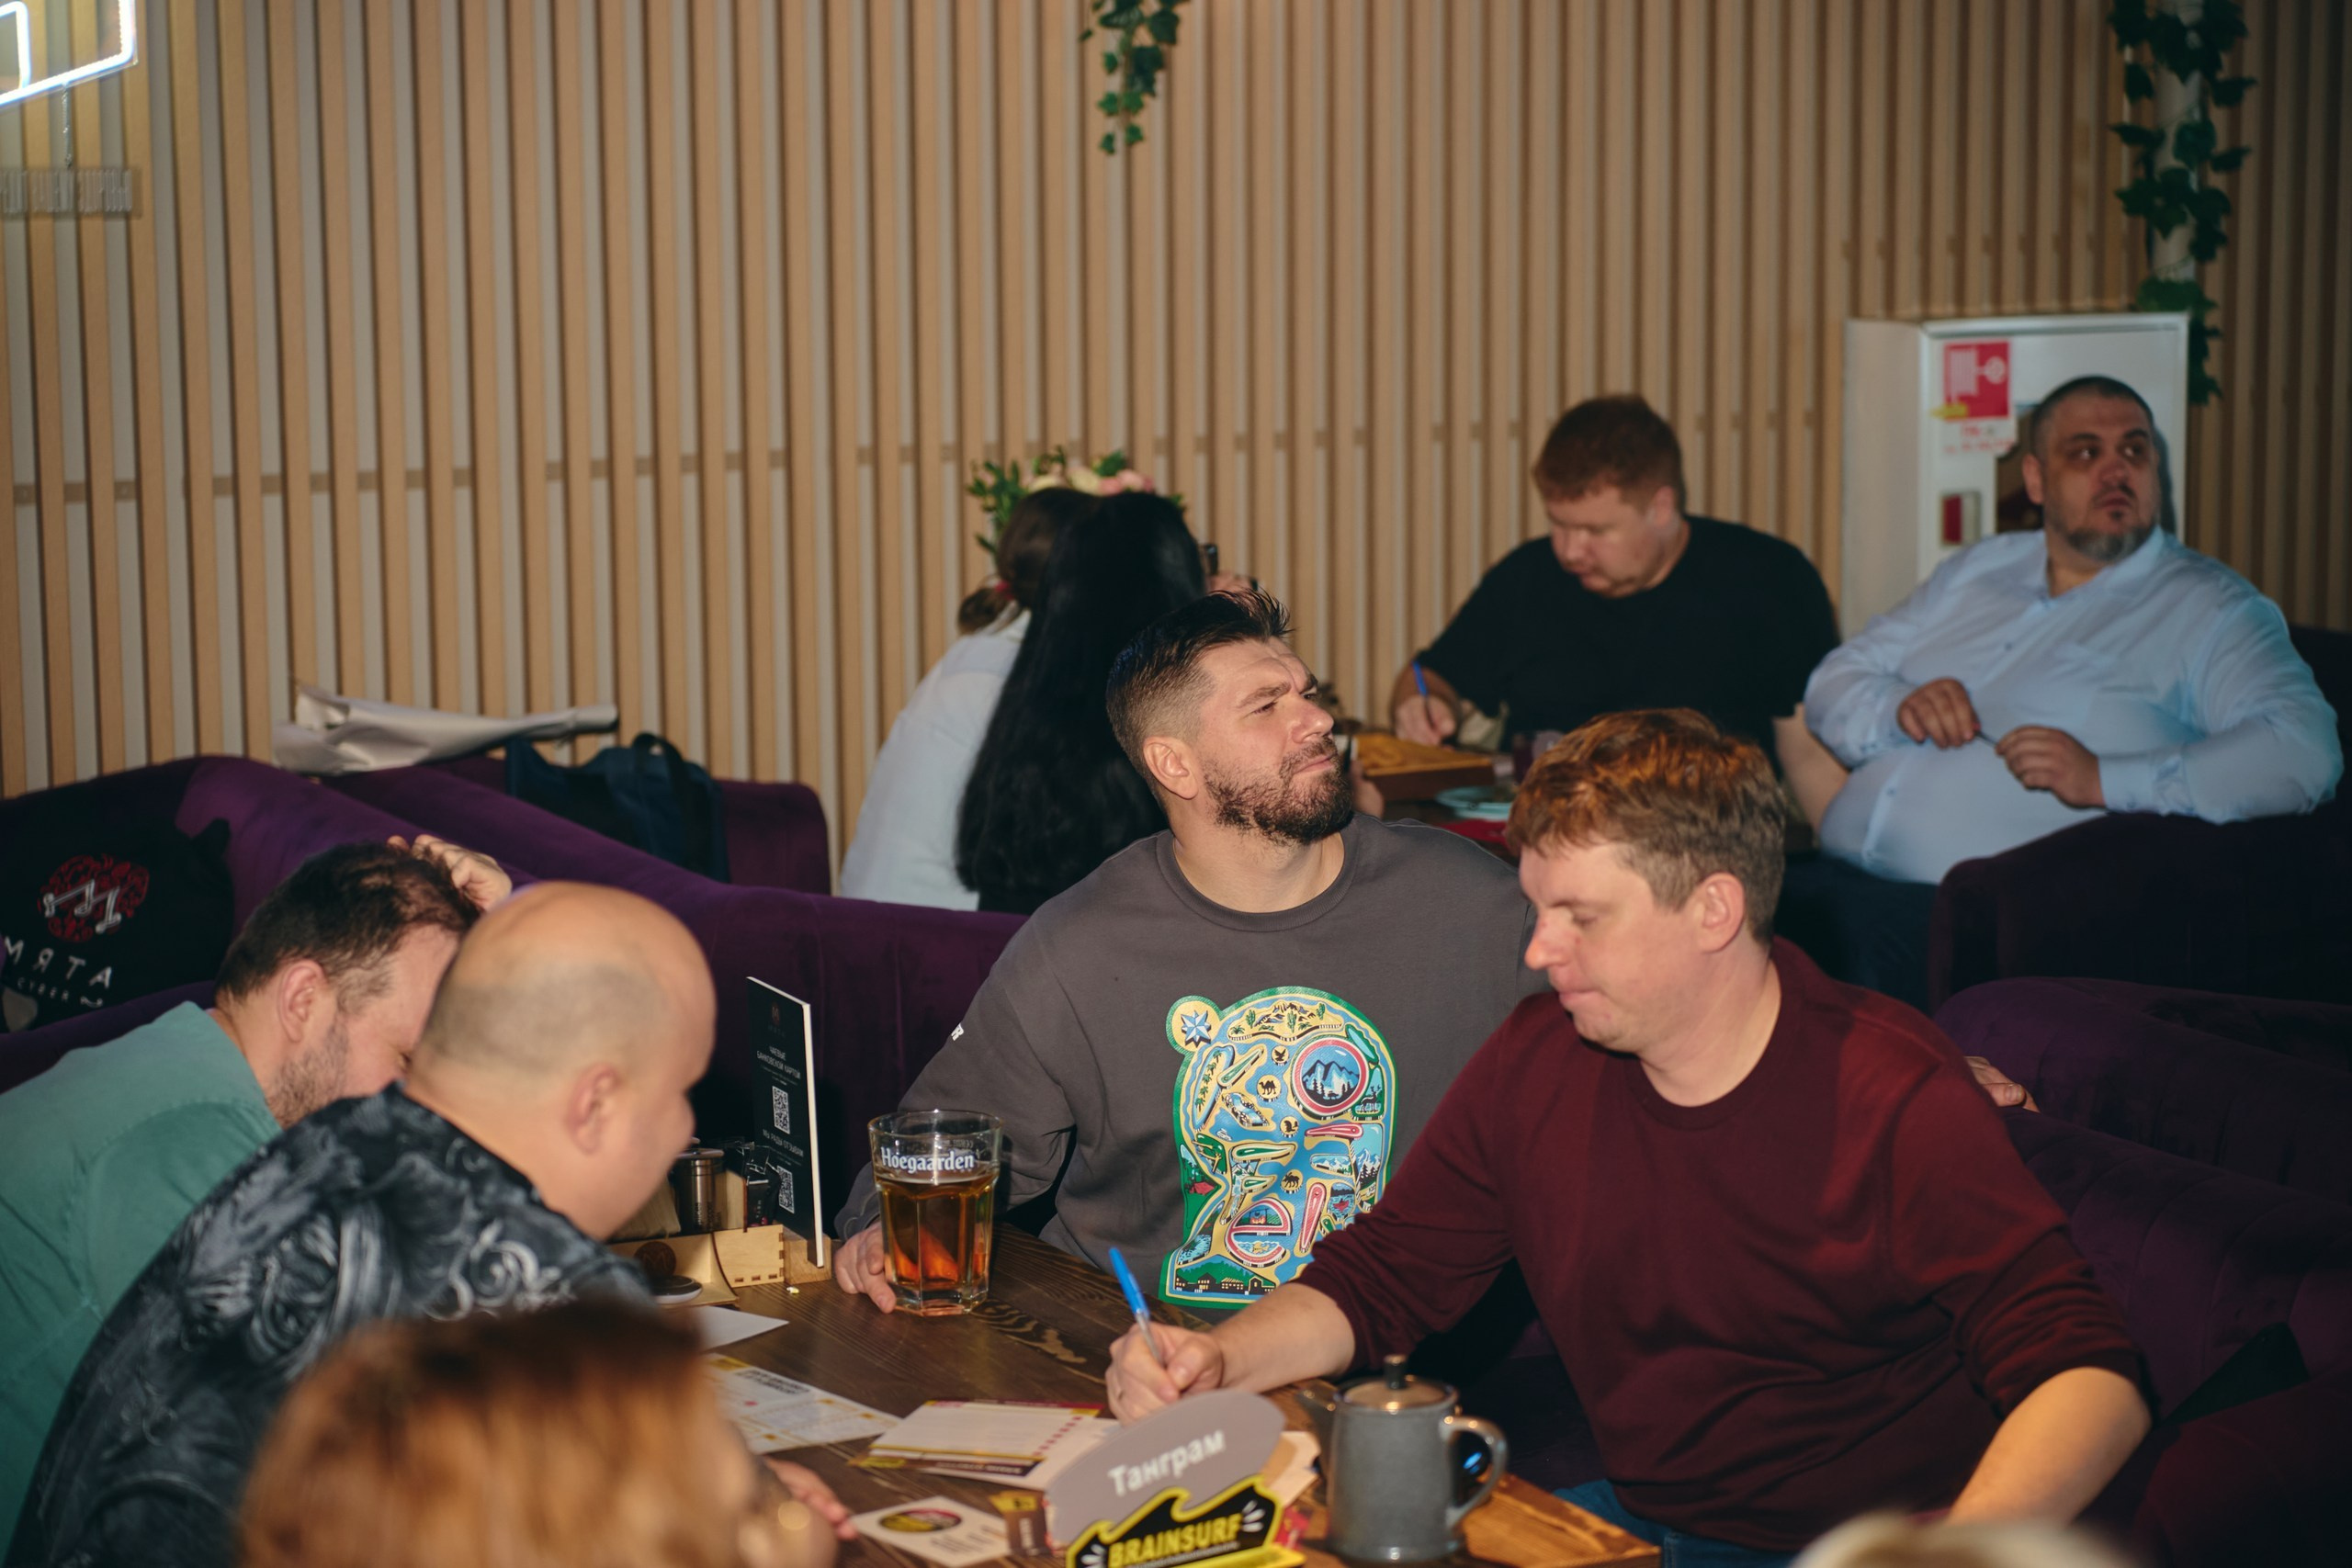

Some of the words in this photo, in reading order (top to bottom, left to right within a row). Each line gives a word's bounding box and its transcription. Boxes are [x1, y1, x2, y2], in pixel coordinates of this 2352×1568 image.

[880, 1147, 975, 1174] Hoegaarden
[1107, 1429, 1226, 1497] Танграм
[1108, 1512, 1243, 1568] BRAINSURF
